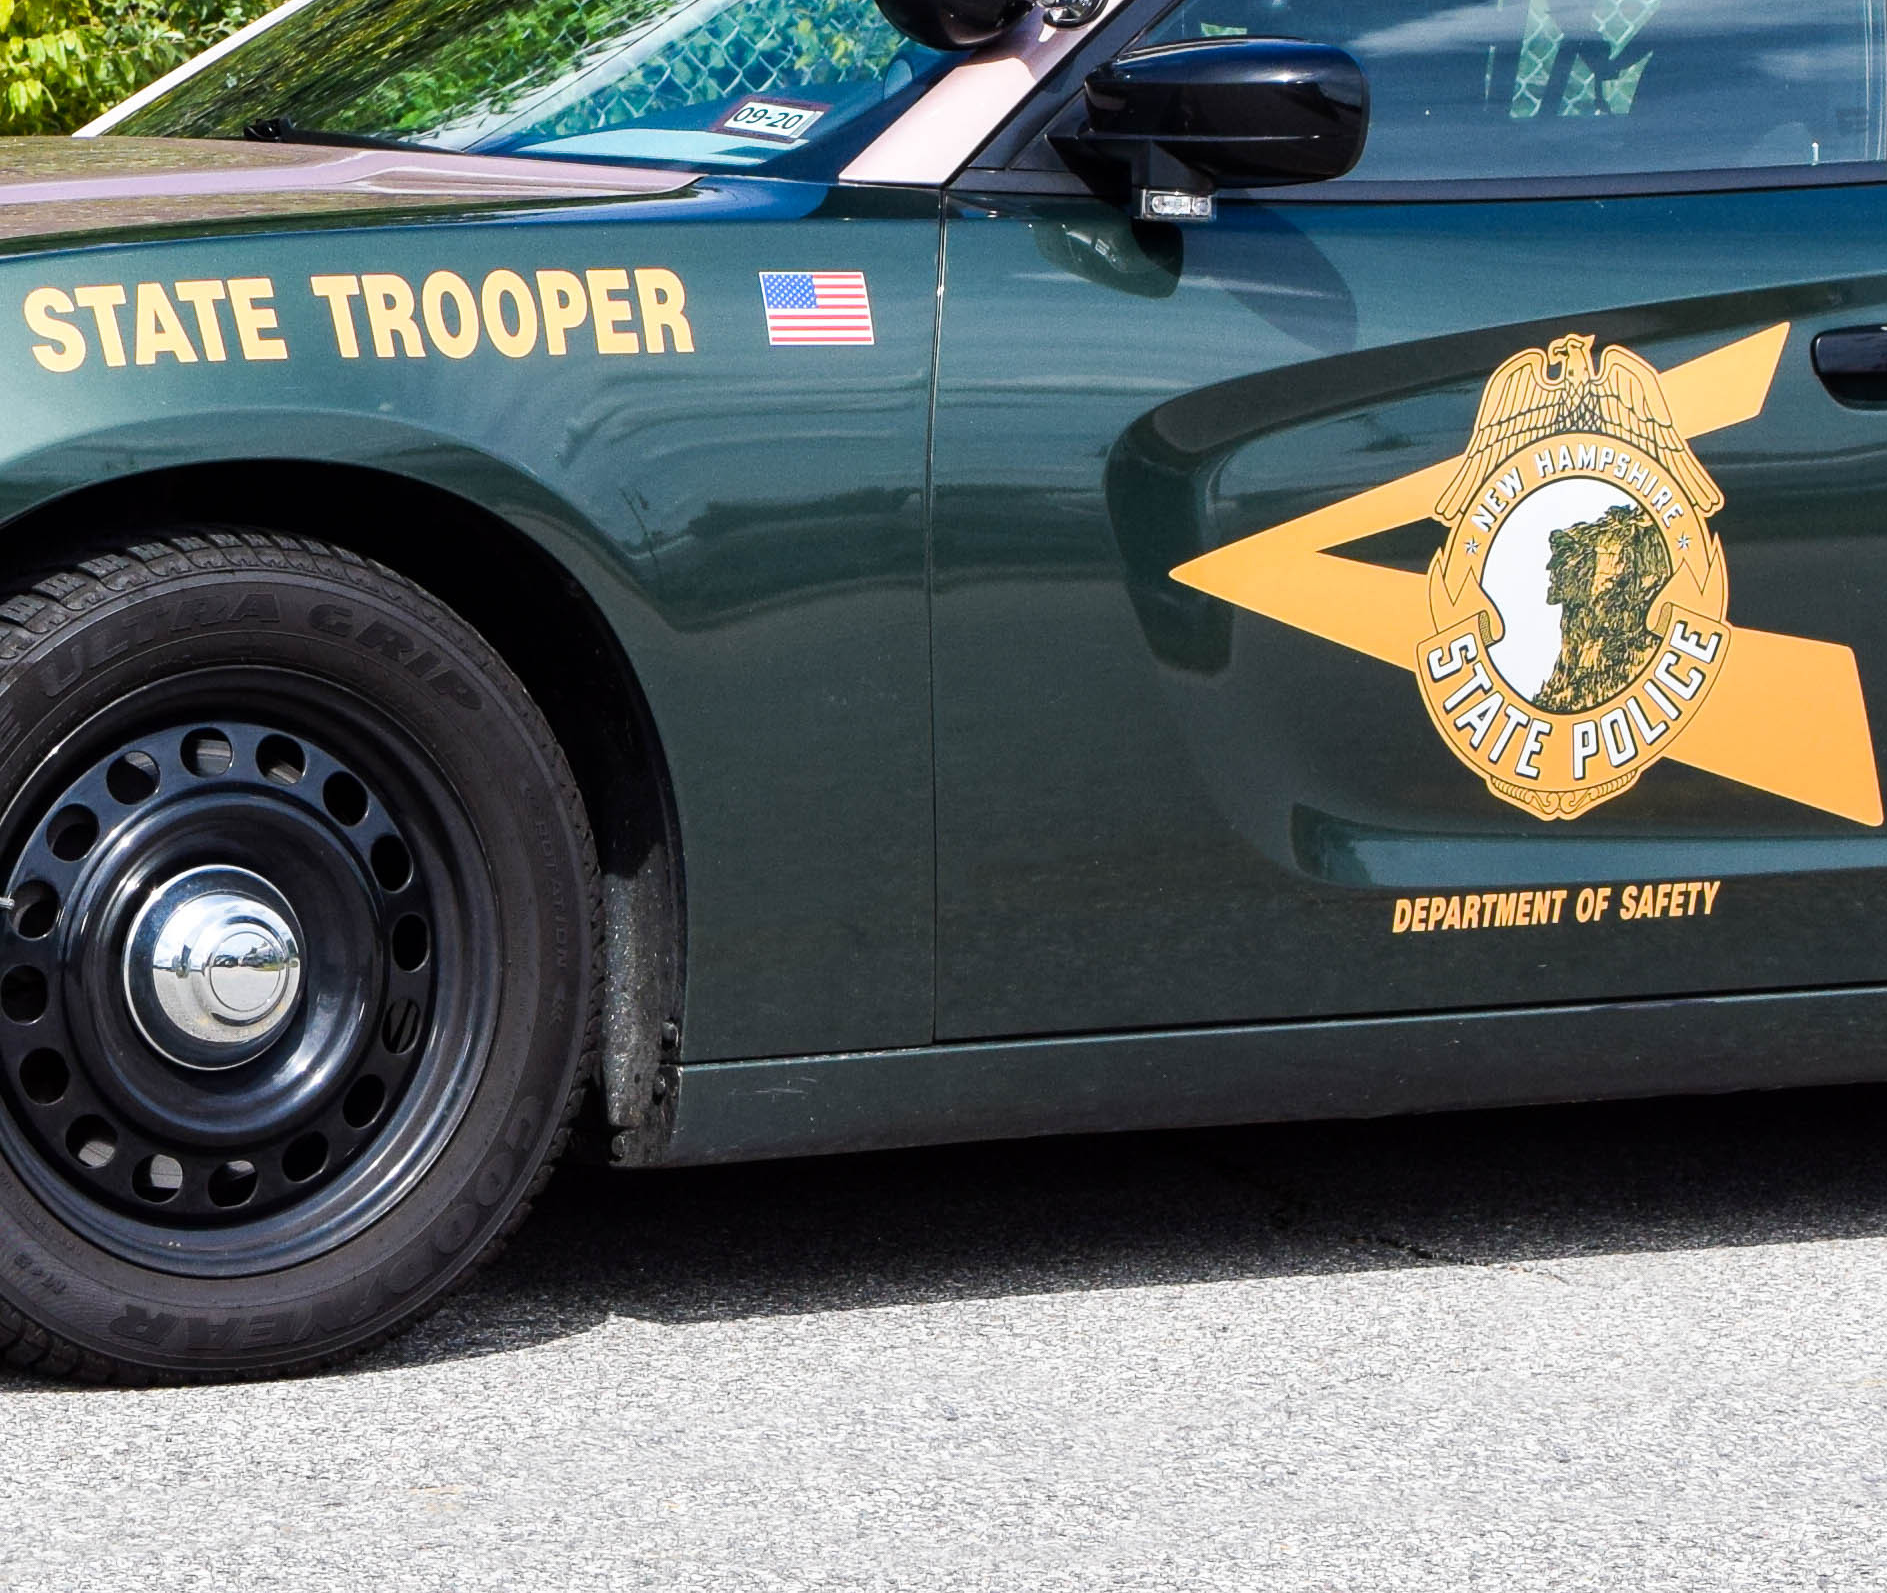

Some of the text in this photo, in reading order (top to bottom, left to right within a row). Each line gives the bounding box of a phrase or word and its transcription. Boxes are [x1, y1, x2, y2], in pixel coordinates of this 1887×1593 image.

[731, 105, 804, 130] 09-20
[23, 268, 695, 373] STATE TROOPER
[1470, 444, 1685, 533] NEW HAMPSHIRE
[39, 590, 282, 699] ULTRA
[308, 600, 487, 713] GRIP
[1428, 619, 1723, 781] STATE POLICE
[1392, 880, 1722, 934] DEPARTMENT OF SAFETY
